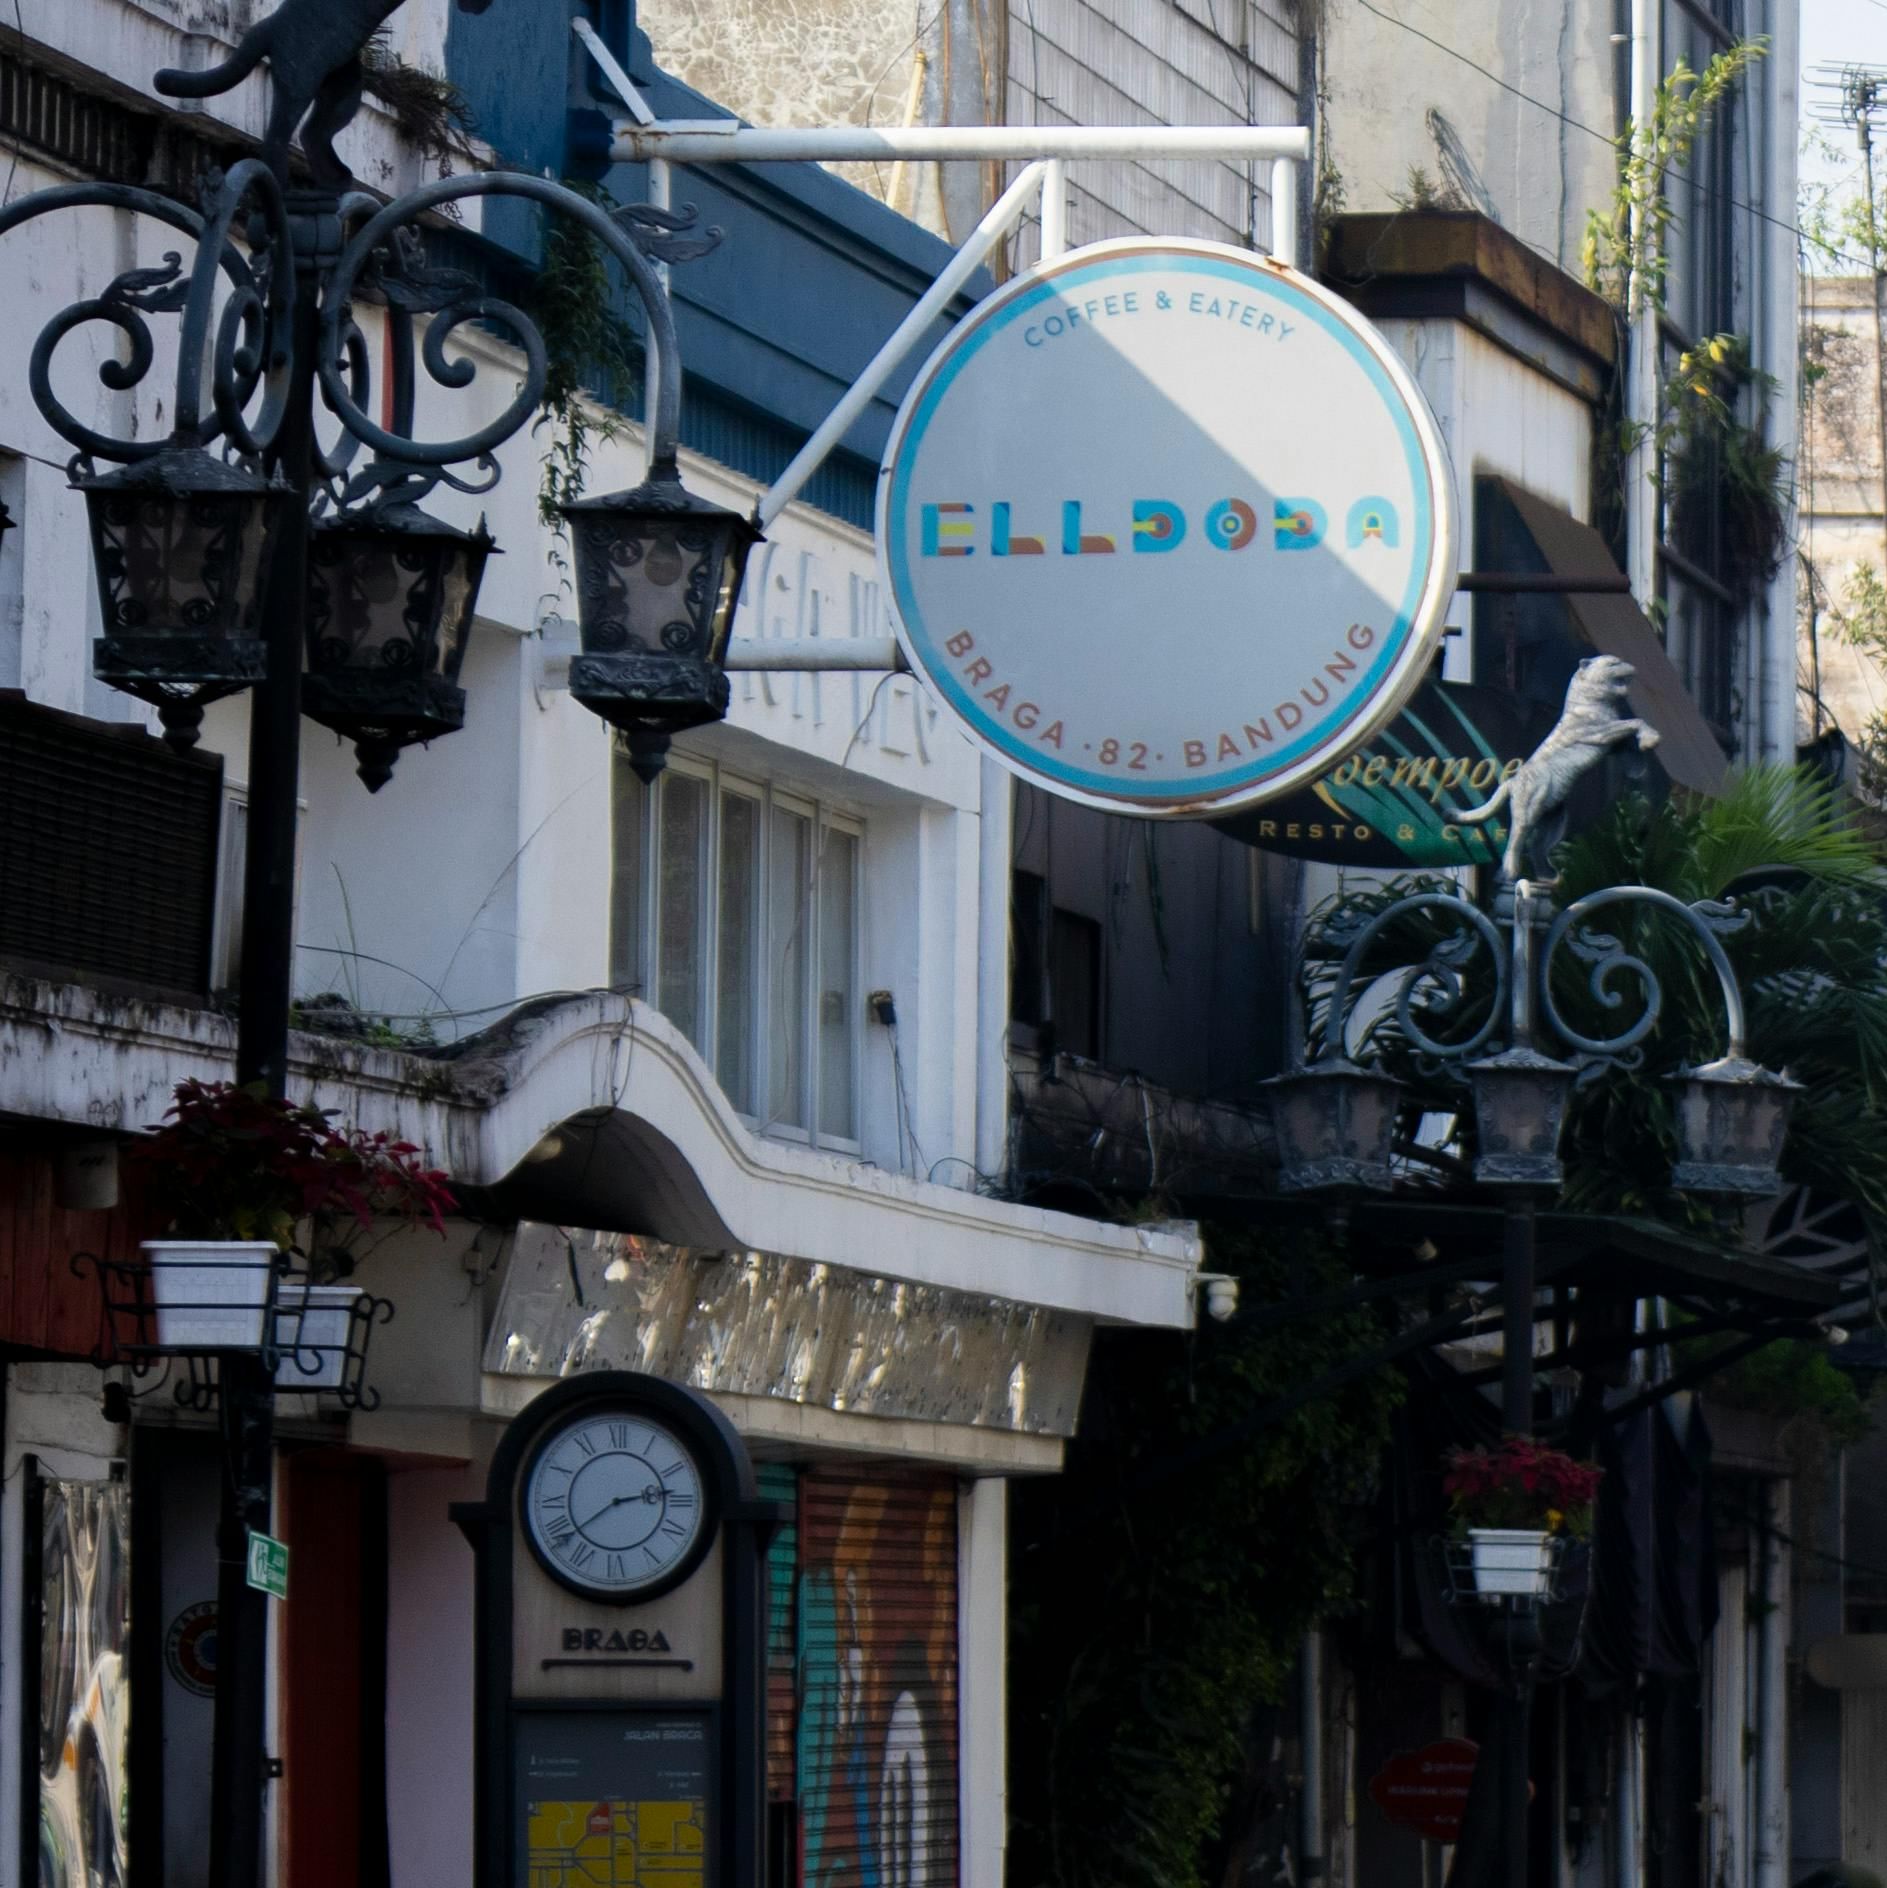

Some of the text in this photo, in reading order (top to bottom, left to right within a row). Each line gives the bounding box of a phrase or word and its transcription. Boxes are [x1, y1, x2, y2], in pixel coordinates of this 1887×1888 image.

[1022, 289, 1297, 350] COFFEE & EATERY
[920, 494, 1401, 557] ELLDODA
[943, 628, 1070, 750] BRAGA
[1182, 620, 1377, 769] BANDUNG
[1257, 818, 1372, 842] RESTO
[1395, 823, 1416, 842] &
[562, 1627, 673, 1654] BRAGA
